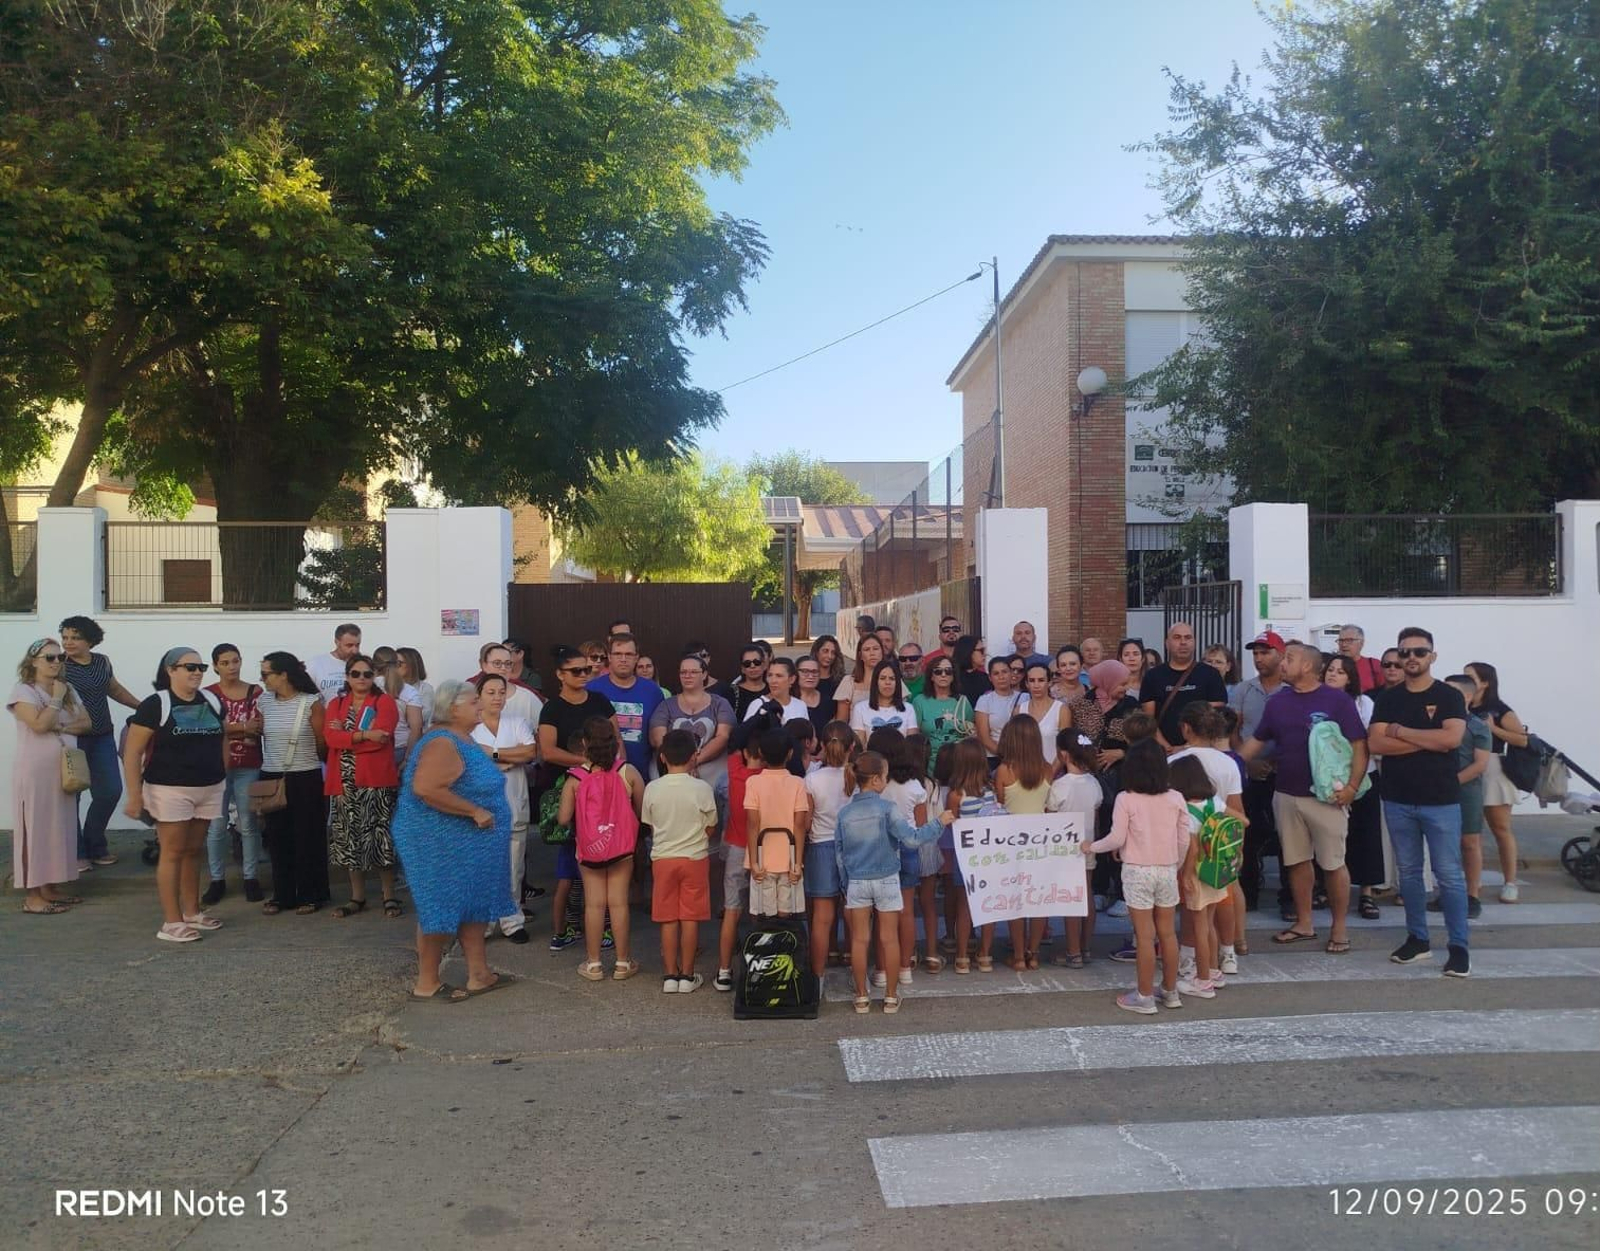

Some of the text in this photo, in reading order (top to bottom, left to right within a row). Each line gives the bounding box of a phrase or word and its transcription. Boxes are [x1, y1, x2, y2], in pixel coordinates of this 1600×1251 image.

[960, 822, 1080, 849] Educación
[968, 851, 1010, 867] con
[966, 872, 1032, 896] No con
[981, 883, 1083, 913] cantidad
